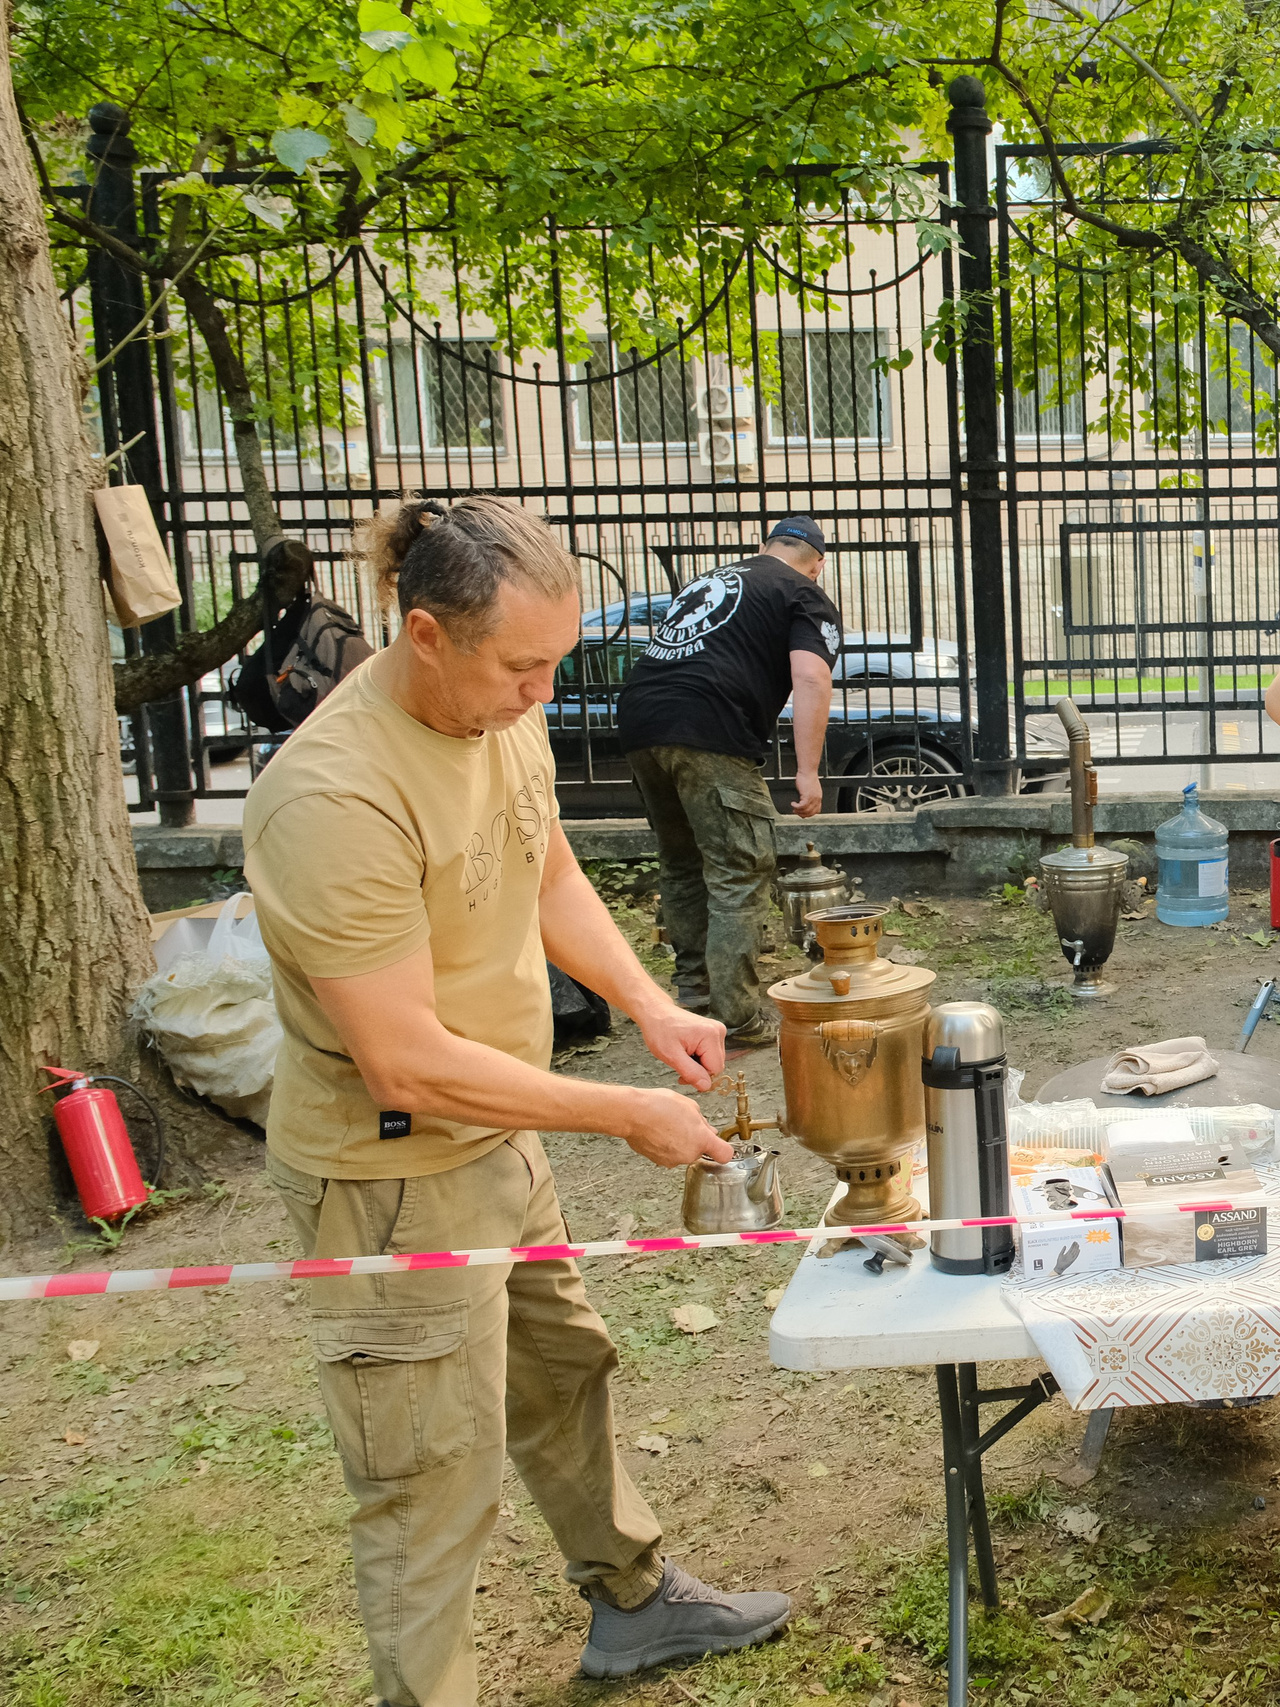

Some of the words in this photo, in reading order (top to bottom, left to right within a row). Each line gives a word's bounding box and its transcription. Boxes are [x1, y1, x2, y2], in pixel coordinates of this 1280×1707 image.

[787, 528, 807, 538] FAMOUS
[384, 1120, 406, 1128] BOSS
[1152, 1171, 1216, 1184] ASSAND
[1212, 1209, 1257, 1223] ASSAND
[1217, 1239, 1258, 1248] HIGHBORN
